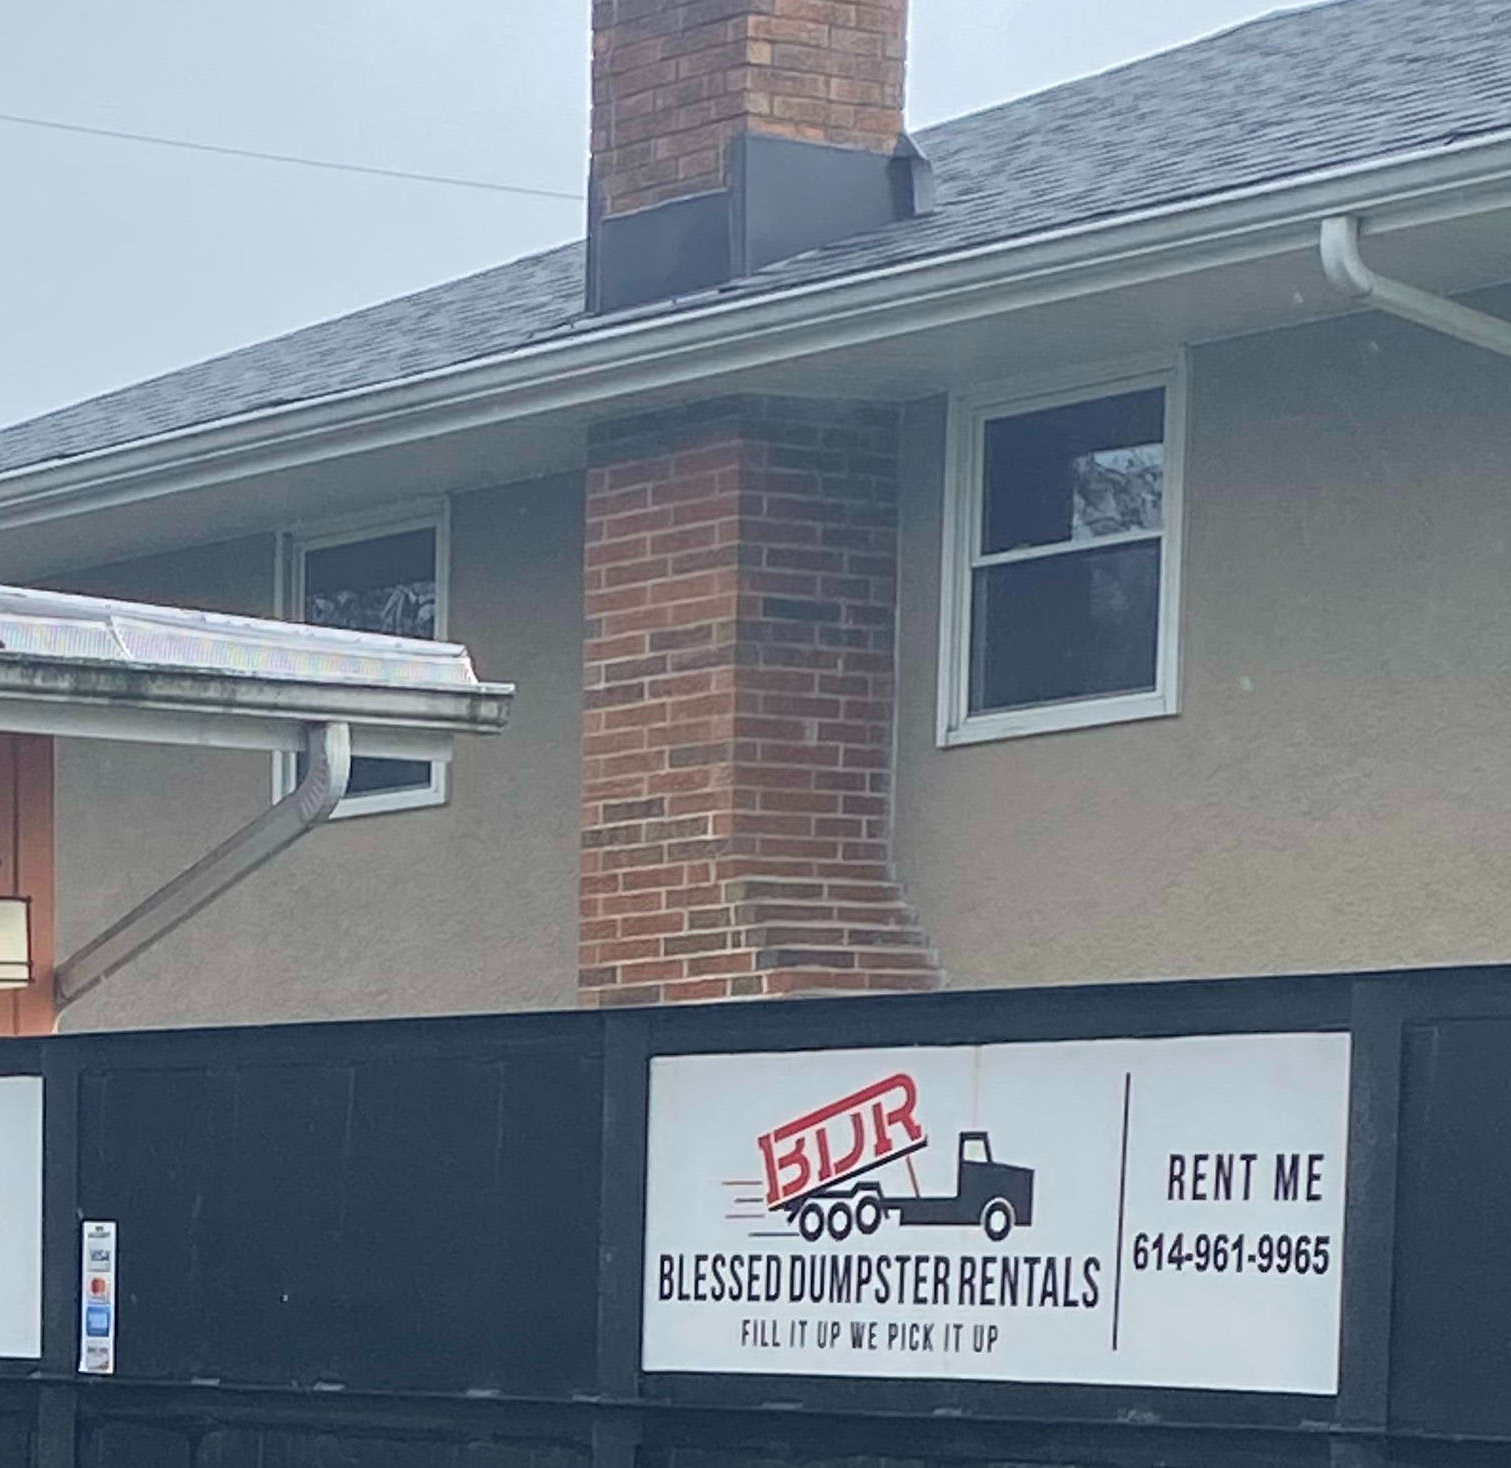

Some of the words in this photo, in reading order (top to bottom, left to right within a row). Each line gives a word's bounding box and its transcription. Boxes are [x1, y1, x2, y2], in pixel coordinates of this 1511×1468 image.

[1167, 1153, 1258, 1201] RENT
[1273, 1153, 1325, 1202] ME
[1133, 1232, 1331, 1275] 614-961-9965
[658, 1253, 783, 1302] BLESSED
[788, 1254, 951, 1306] DUMPSTER
[958, 1256, 1102, 1309] RENTALS
[741, 1319, 782, 1348] FILL
[789, 1320, 808, 1349] IT
[816, 1321, 841, 1350] UP
[850, 1322, 879, 1351] WE
[887, 1322, 935, 1352] PICK
[944, 1323, 964, 1353] IT
[973, 1324, 999, 1353] UP
